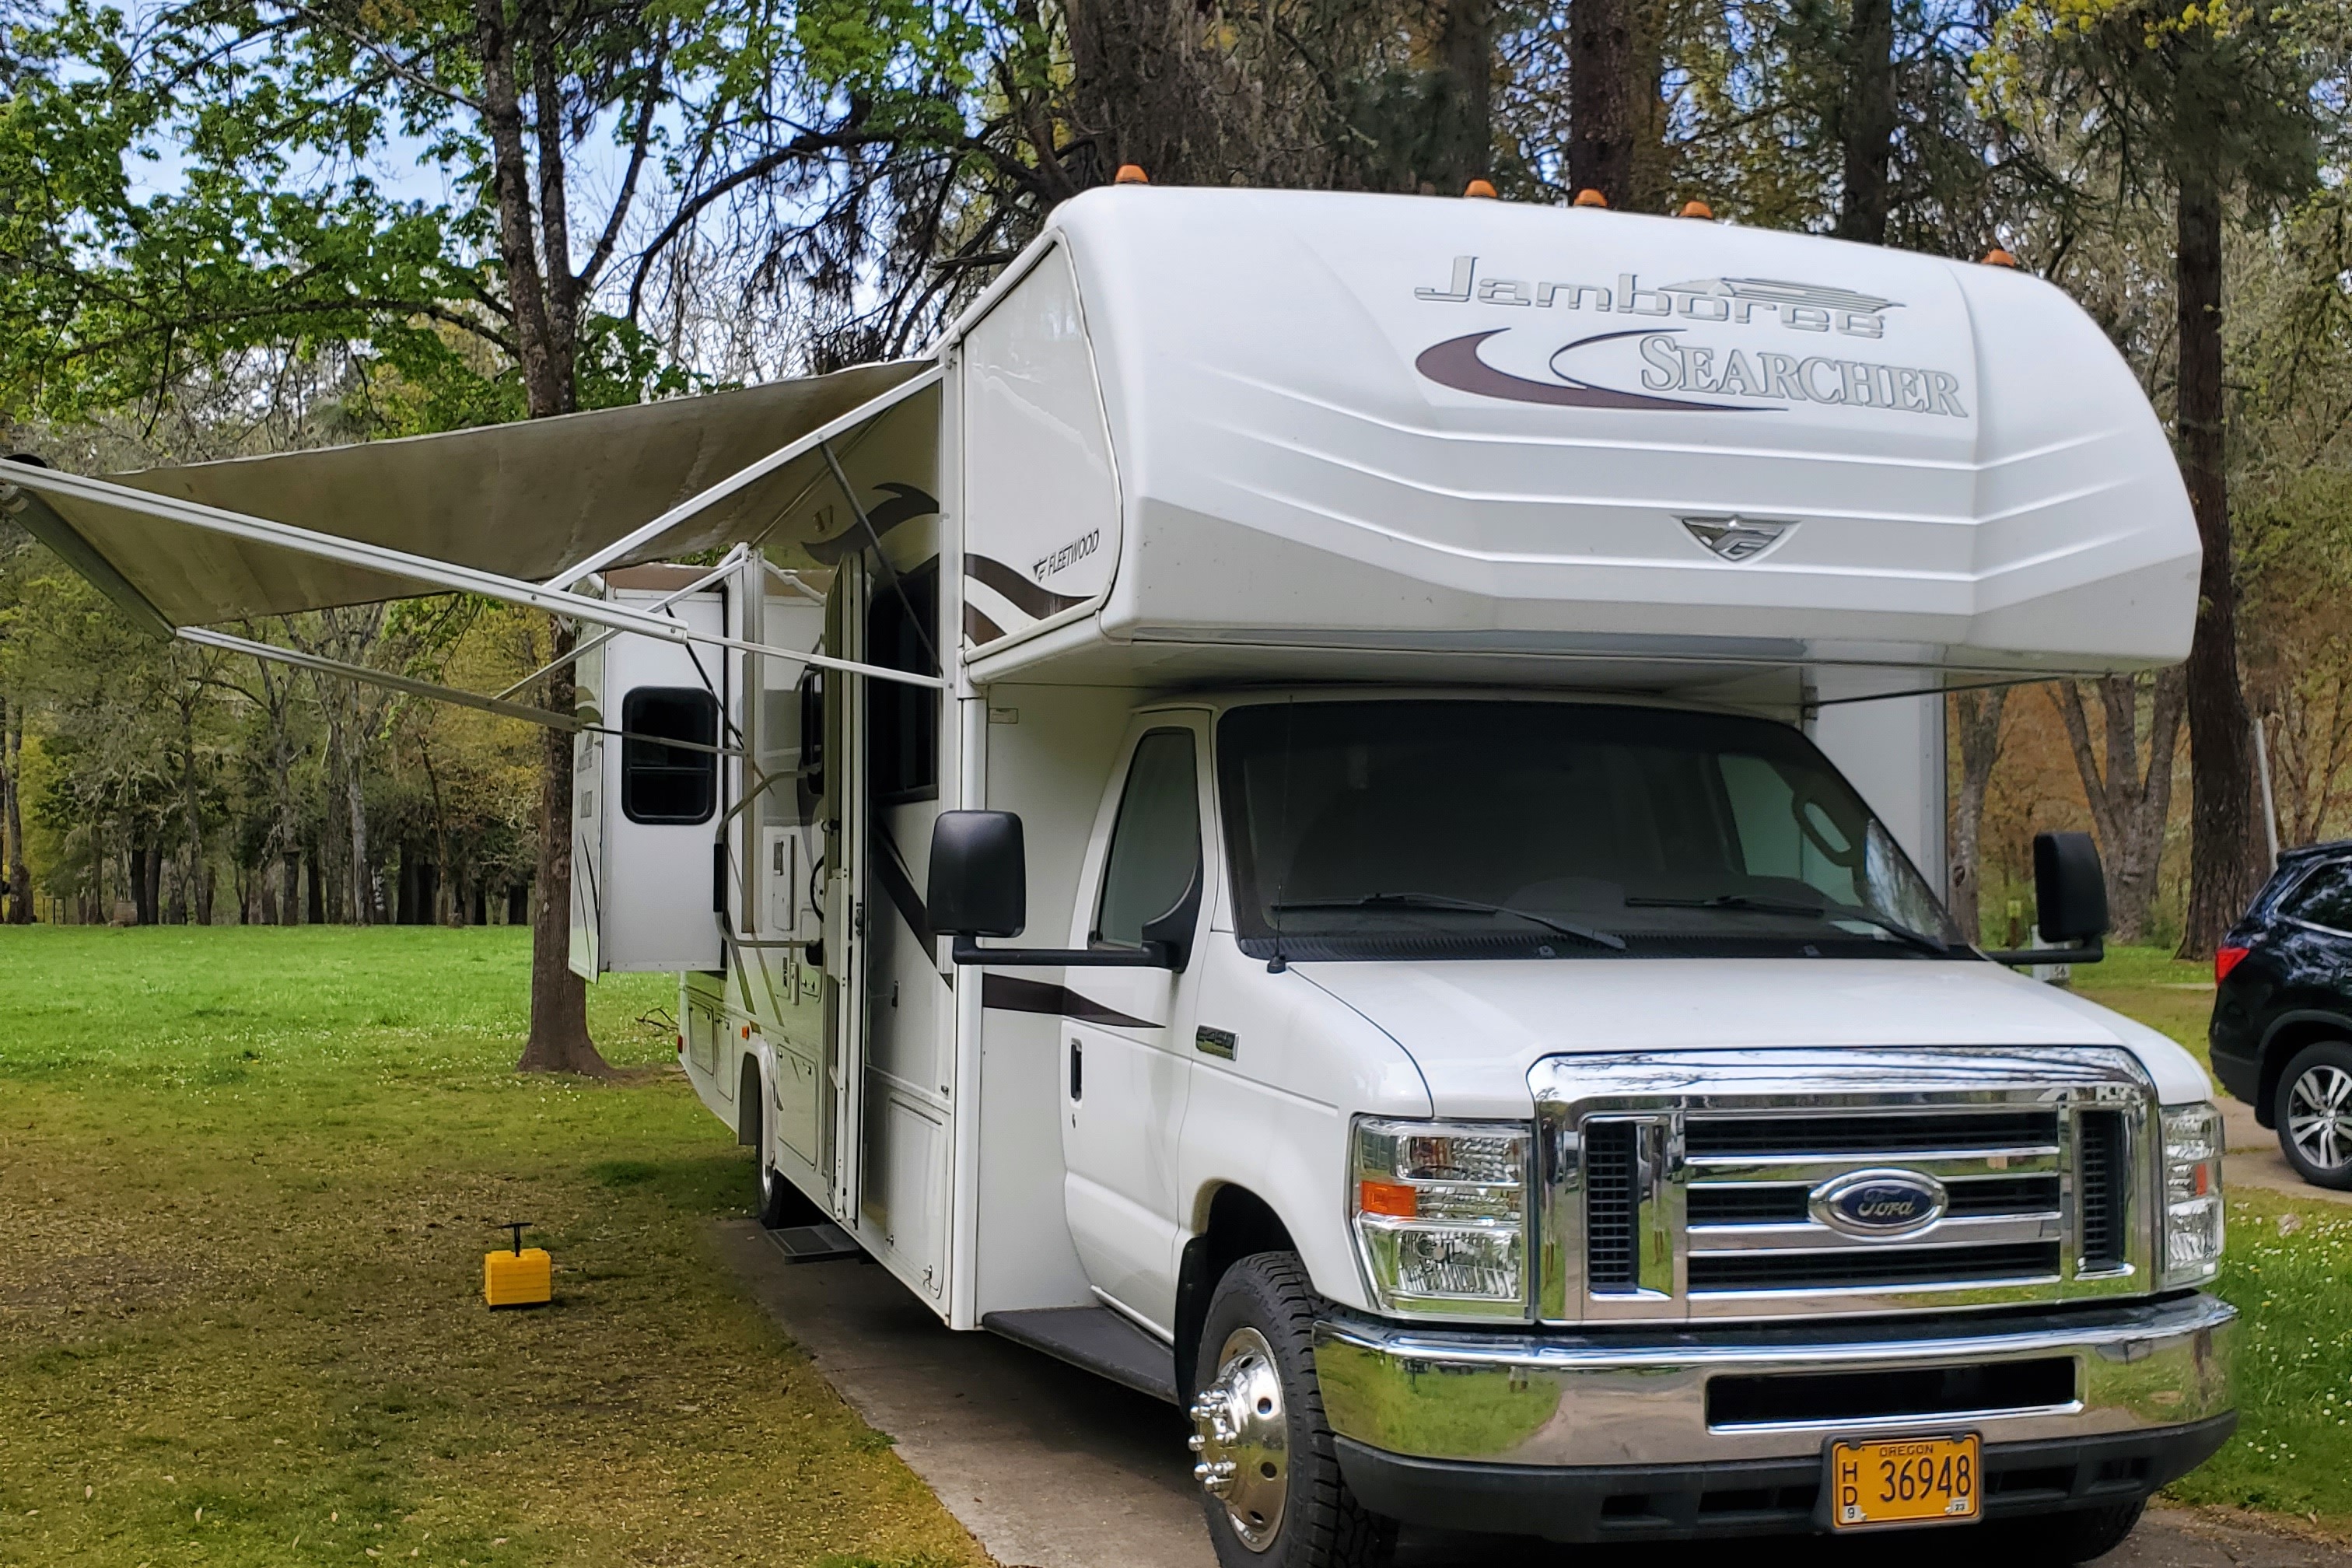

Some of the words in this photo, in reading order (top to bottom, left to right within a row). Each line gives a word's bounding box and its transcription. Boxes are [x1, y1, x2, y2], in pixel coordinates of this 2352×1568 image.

[1413, 255, 1885, 338] Jamboree
[1640, 334, 1968, 418] SEARCHER
[1048, 528, 1099, 576] FLEETWOOD
[1857, 1188, 1916, 1216] Ford
[1879, 1444, 1934, 1457] OREGON
[1880, 1454, 1971, 1502] 36948
[1847, 1507, 1855, 1519] 9
